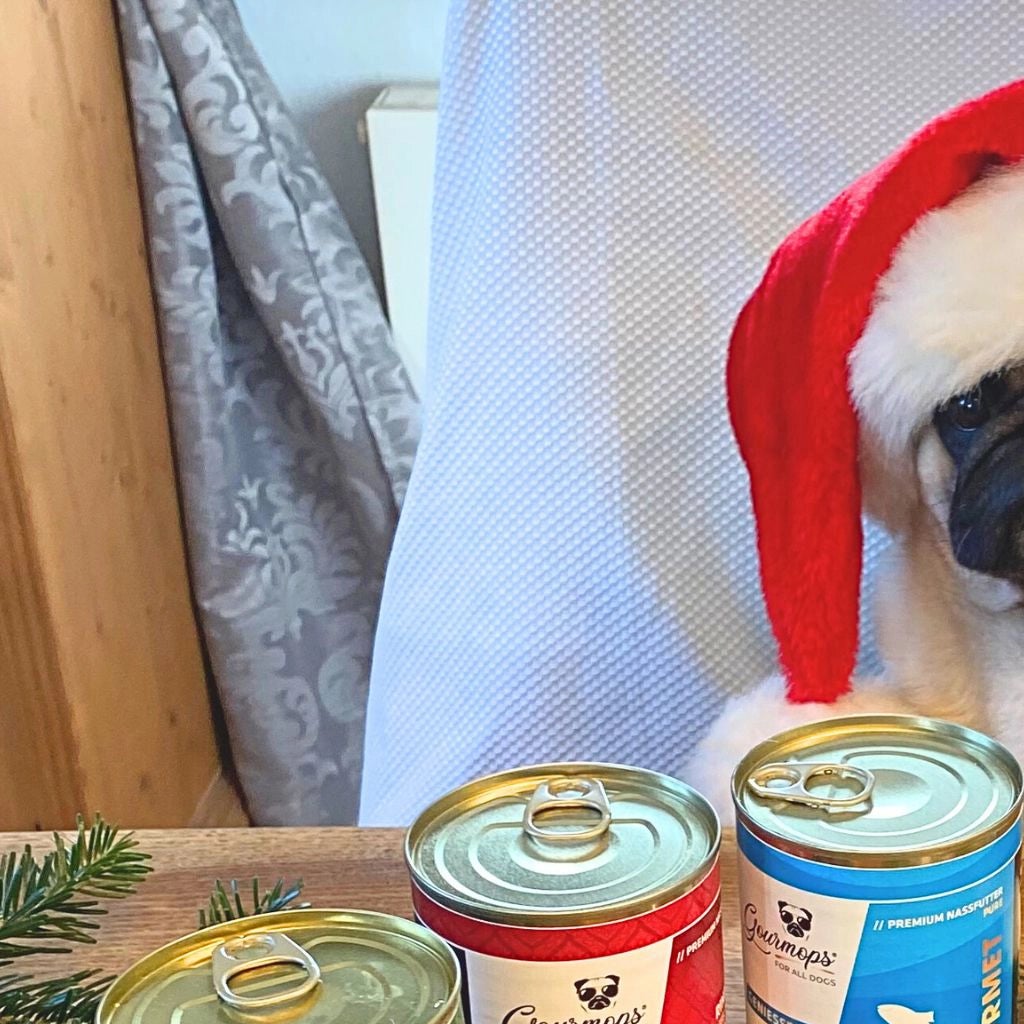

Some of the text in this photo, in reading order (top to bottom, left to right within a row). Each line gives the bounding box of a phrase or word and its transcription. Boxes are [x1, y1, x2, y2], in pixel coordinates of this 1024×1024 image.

[886, 912, 944, 929] PREMIUM
[946, 886, 1004, 920] NASSFUTTER
[774, 960, 837, 987] FOR ALL DOGS
